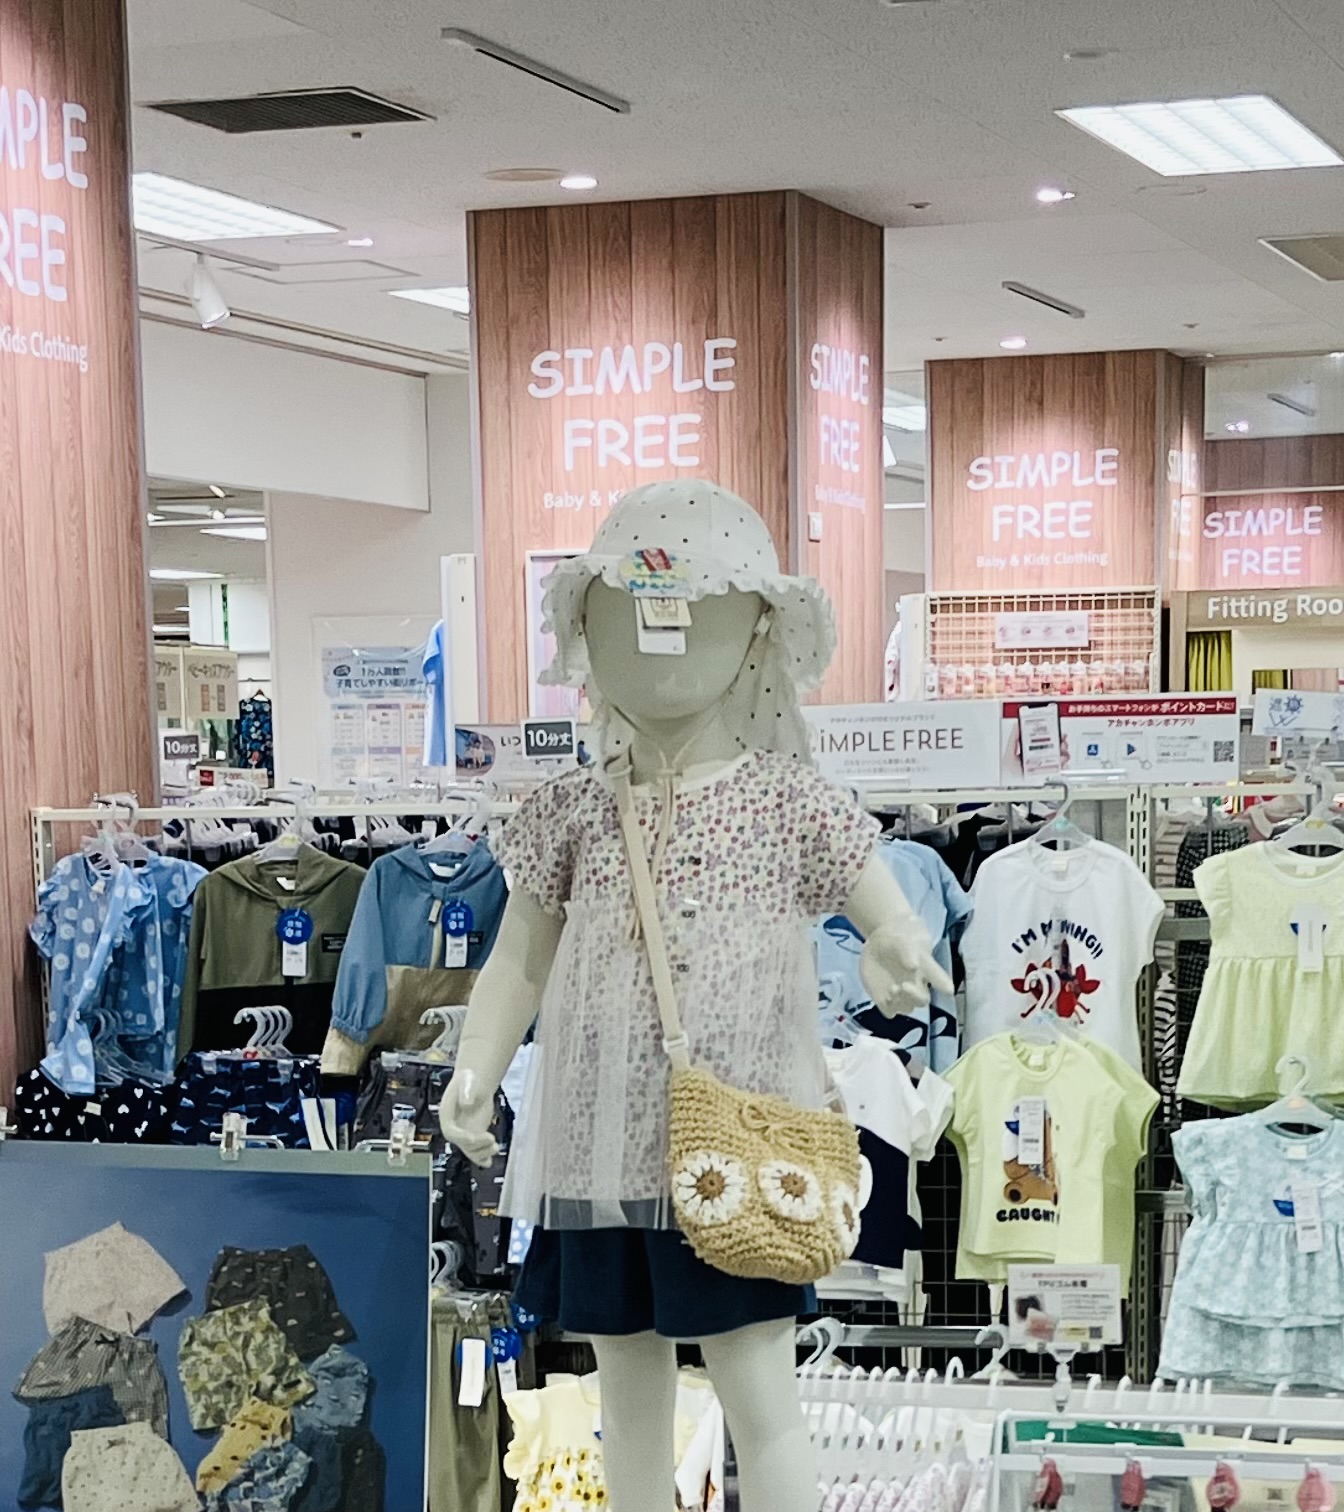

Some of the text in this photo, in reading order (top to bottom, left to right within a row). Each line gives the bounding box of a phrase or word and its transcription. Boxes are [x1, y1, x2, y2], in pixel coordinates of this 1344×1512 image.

[30, 331, 89, 373] Clothing
[527, 337, 738, 400] SIMPLE
[809, 343, 870, 406] SIMPLE
[562, 412, 701, 472] FREE
[820, 414, 860, 473] FREE
[966, 448, 1119, 491] SIMPLE
[543, 490, 584, 512] Baby
[589, 490, 601, 507] &
[992, 500, 1093, 542] FREE
[1203, 505, 1324, 539] SIMPLE
[976, 555, 1007, 571] Baby
[1053, 550, 1110, 568] Clothing
[1221, 545, 1303, 577] FREE
[1207, 594, 1289, 623] Fitting
[527, 729, 572, 748] 10分丈
[811, 728, 964, 753] iMPLE FREE
